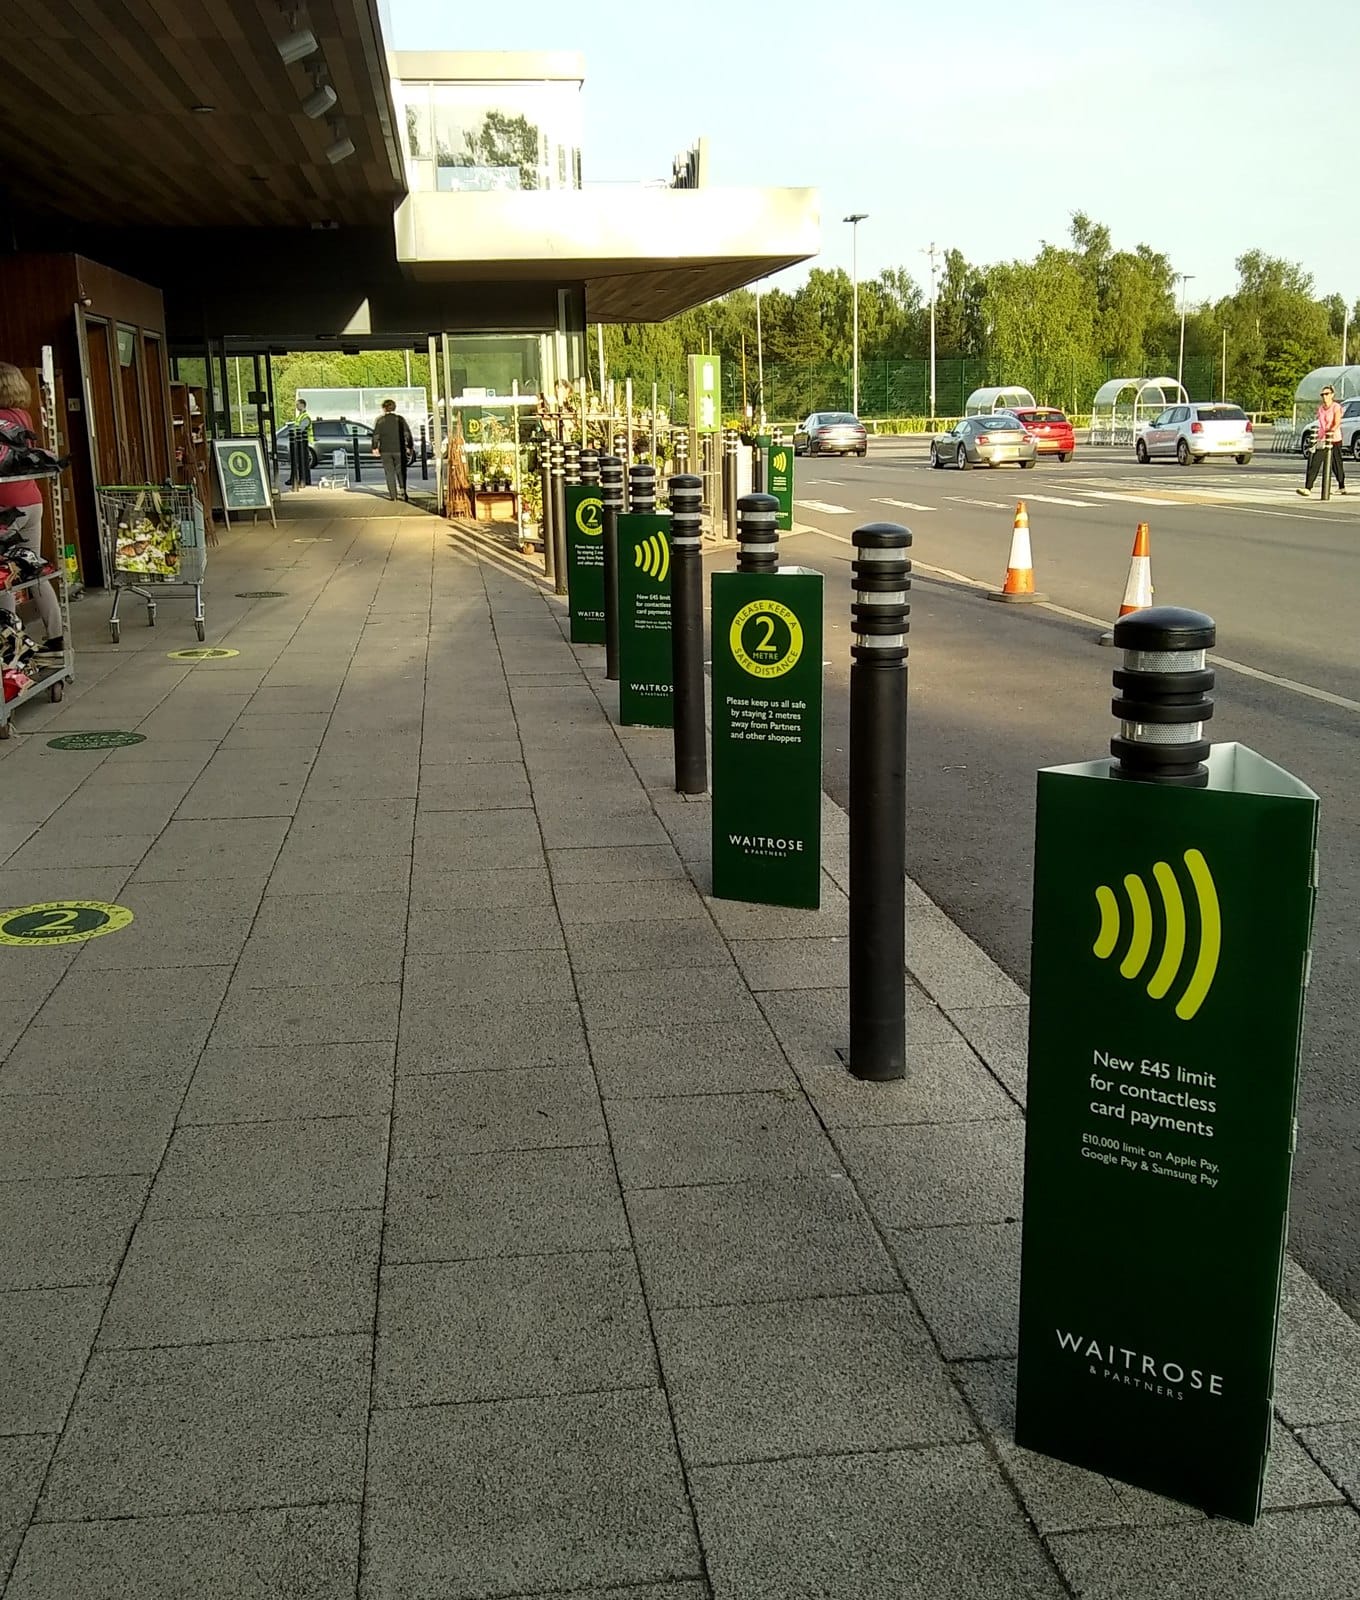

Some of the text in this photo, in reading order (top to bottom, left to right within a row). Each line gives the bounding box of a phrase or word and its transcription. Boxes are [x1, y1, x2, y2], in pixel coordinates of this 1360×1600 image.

[587, 505, 598, 523] 2
[735, 602, 797, 629] PLEASE KEEP A
[756, 616, 776, 651] 2
[735, 648, 798, 675] SAFE DISTANCE
[753, 652, 779, 660] METRE
[630, 683, 674, 693] WAITROS
[726, 696, 749, 706] Please
[751, 698, 769, 709] keep
[781, 700, 790, 708] all
[791, 701, 806, 709] safe
[730, 708, 740, 718] by
[741, 710, 767, 720] staying
[768, 710, 774, 718] 2
[730, 731, 802, 744] and other shoppers
[731, 721, 801, 731] away from Partners
[728, 834, 803, 851] WAITROSE
[30, 910, 79, 932] 2
[22, 929, 75, 937] METRE
[1093, 1049, 1216, 1088] New £45 limit
[1090, 1073, 1216, 1113] for contactless
[1090, 1102, 1214, 1137] card payments
[1122, 1142, 1145, 1156] limit
[1148, 1151, 1162, 1160] on
[1165, 1152, 1197, 1167] Apple
[1081, 1147, 1219, 1188] Google Pay & Samsung Pay
[1056, 1328, 1223, 1396] WAITROSE
[1089, 1365, 1184, 1401] & PARTNERS
